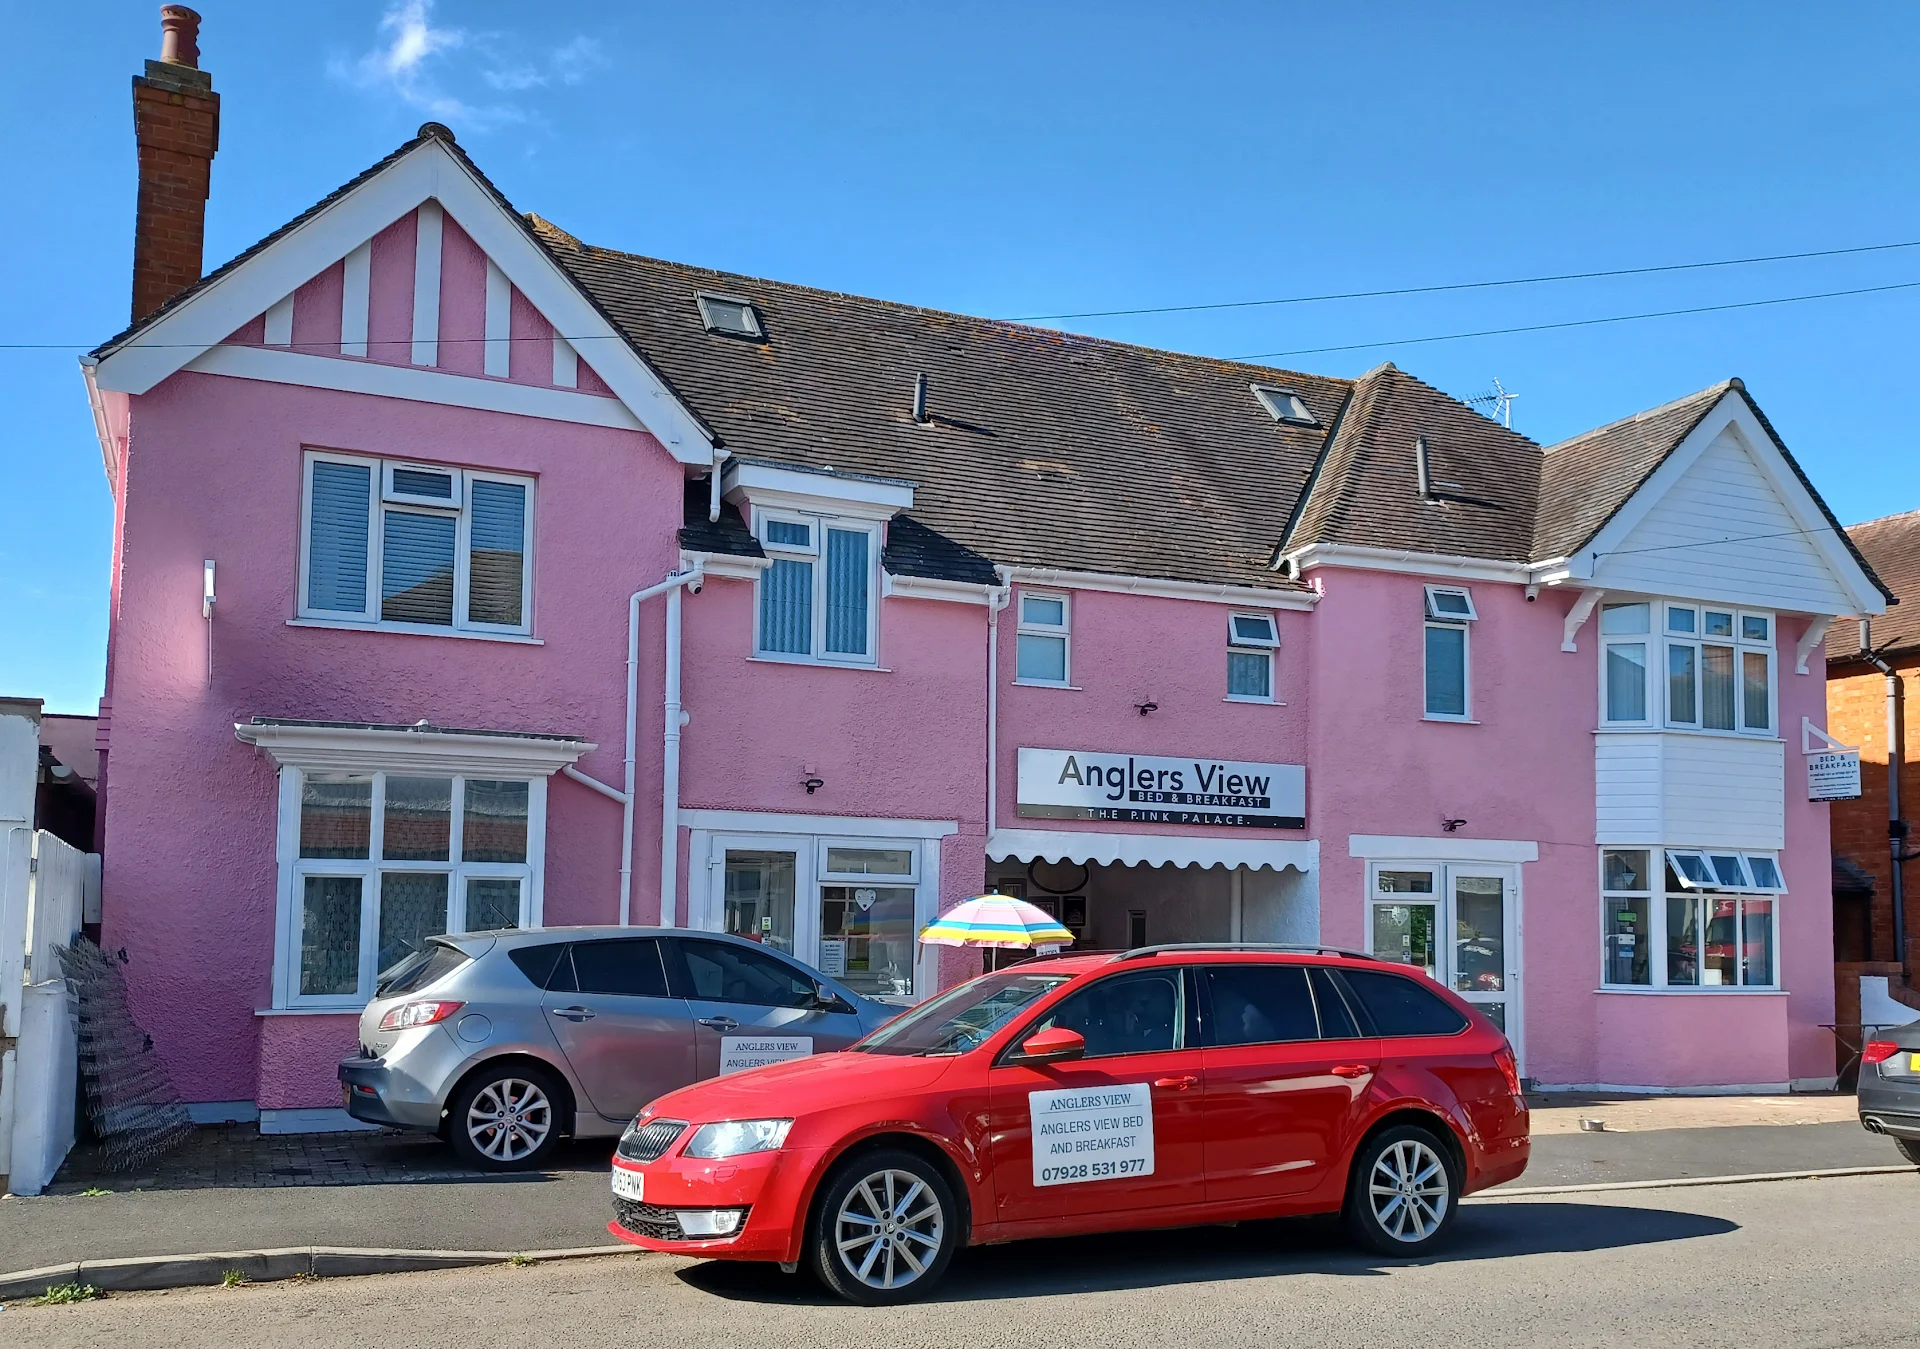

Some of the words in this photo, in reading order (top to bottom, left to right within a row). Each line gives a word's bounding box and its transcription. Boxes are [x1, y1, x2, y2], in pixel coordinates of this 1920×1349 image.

[1810, 761, 1856, 770] BREAKFAST
[1058, 755, 1184, 801] Anglers
[1194, 763, 1270, 796] View
[1138, 792, 1164, 802] BED
[1171, 793, 1179, 803] &
[1186, 794, 1262, 807] BREAKFAST
[1088, 808, 1118, 819] THE
[1131, 811, 1169, 822] PINK
[1182, 813, 1243, 825] PALACE
[736, 1042, 774, 1050] ANGLERS
[776, 1042, 798, 1050] VIEW
[726, 1058, 765, 1068] ANGLERS
[1050, 1096, 1101, 1110] ANGLERS
[1102, 1094, 1131, 1106] VIEW
[1040, 1120, 1091, 1136] ANGLERS
[1094, 1118, 1120, 1130] VIEW
[1123, 1116, 1144, 1128] BED
[1050, 1142, 1072, 1154] AND
[1076, 1136, 1136, 1152] BREAKFAST
[1042, 1164, 1088, 1181] 07928
[1092, 1162, 1116, 1176] 531
[1120, 1158, 1145, 1173] 977
